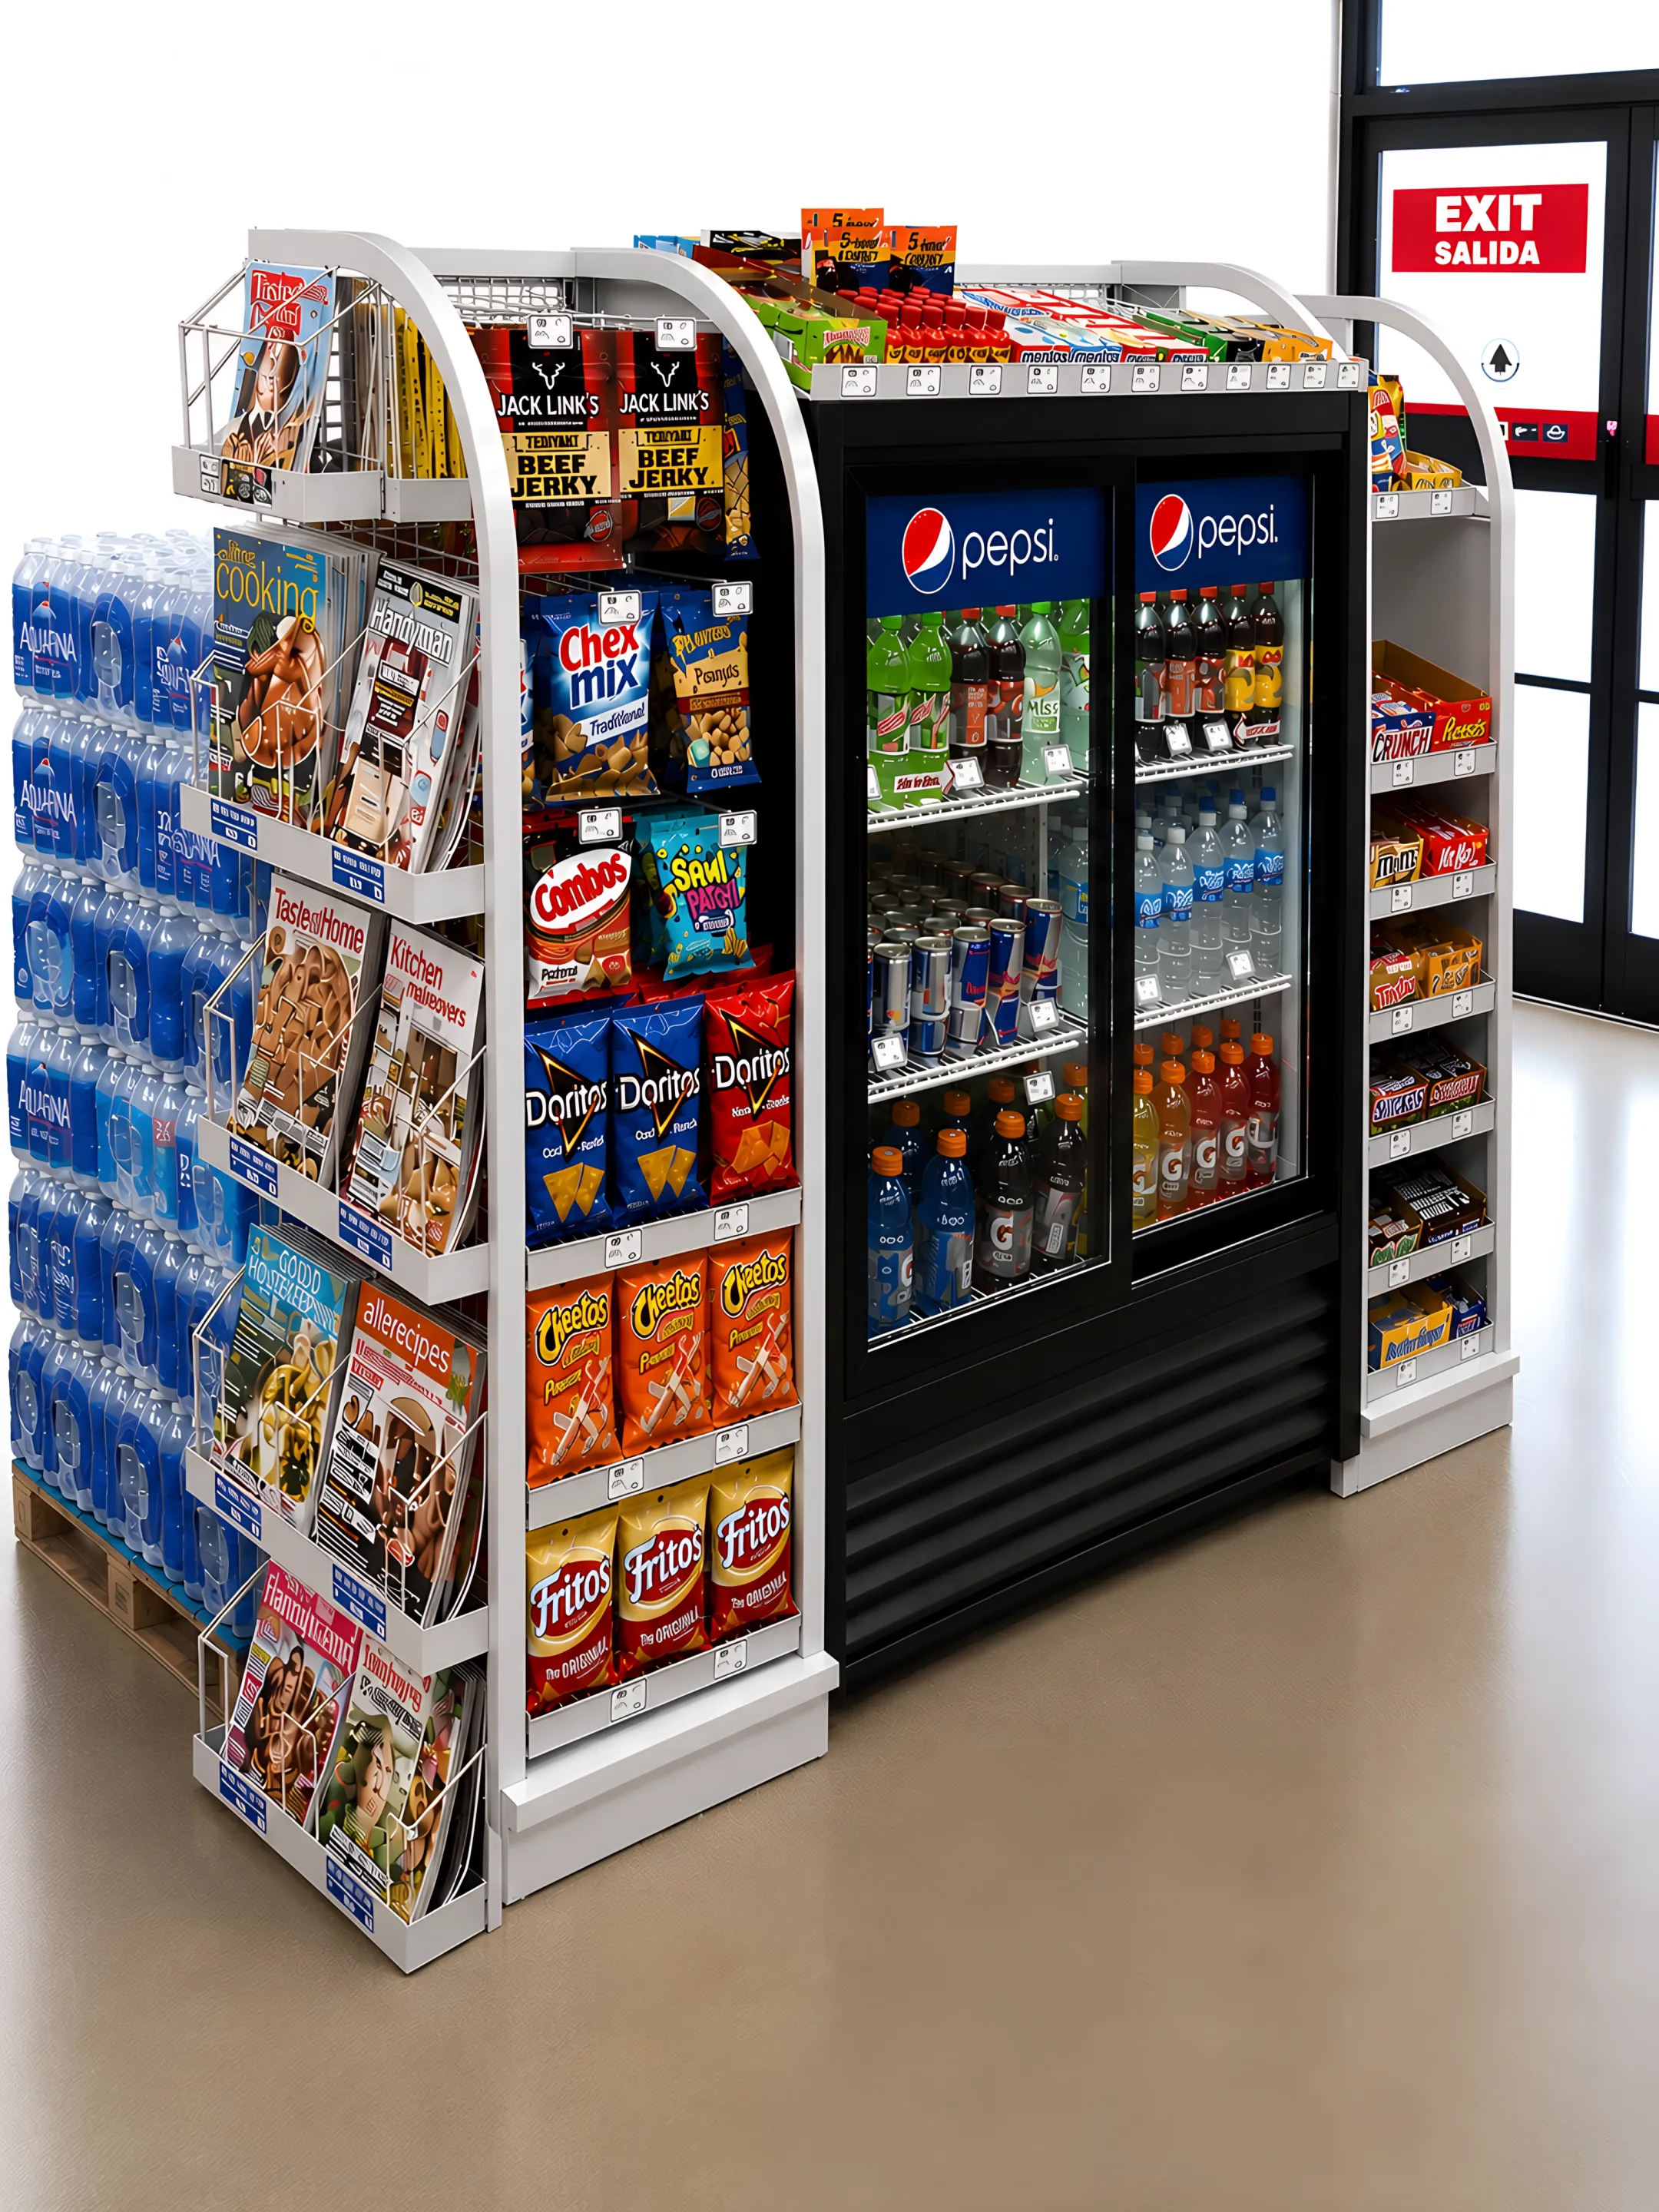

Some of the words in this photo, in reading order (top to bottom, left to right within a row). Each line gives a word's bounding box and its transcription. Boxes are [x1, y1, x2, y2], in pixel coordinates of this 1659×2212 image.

[1435, 194, 1542, 232] EXIT
[1434, 240, 1541, 265] SALIDA
[497, 394, 542, 416] JACK
[546, 392, 600, 417] LINK'S
[619, 393, 660, 413] JACK
[664, 390, 710, 412] LINK'S
[518, 455, 586, 475] BEEF
[638, 448, 699, 469] BEEF
[511, 475, 598, 498] JERKY
[962, 518, 1055, 580] pepsi
[1198, 504, 1275, 559] pepsi
[216, 561, 320, 634] cooking
[560, 623, 640, 671] Chex
[570, 653, 638, 709] mix
[535, 853, 628, 922] Combos
[390, 935, 443, 990] Kitchen
[620, 1067, 700, 1111] Doritos
[715, 1046, 790, 1090] Doritos
[526, 1081, 608, 1128] Doritos
[634, 1274, 700, 1331] Cheetos
[724, 1253, 786, 1314] Cheetos
[539, 1295, 608, 1362] Cheetos
[717, 1494, 790, 1569] Fritos
[624, 1527, 702, 1604] Fritos
[530, 1555, 611, 1637] Fritos
